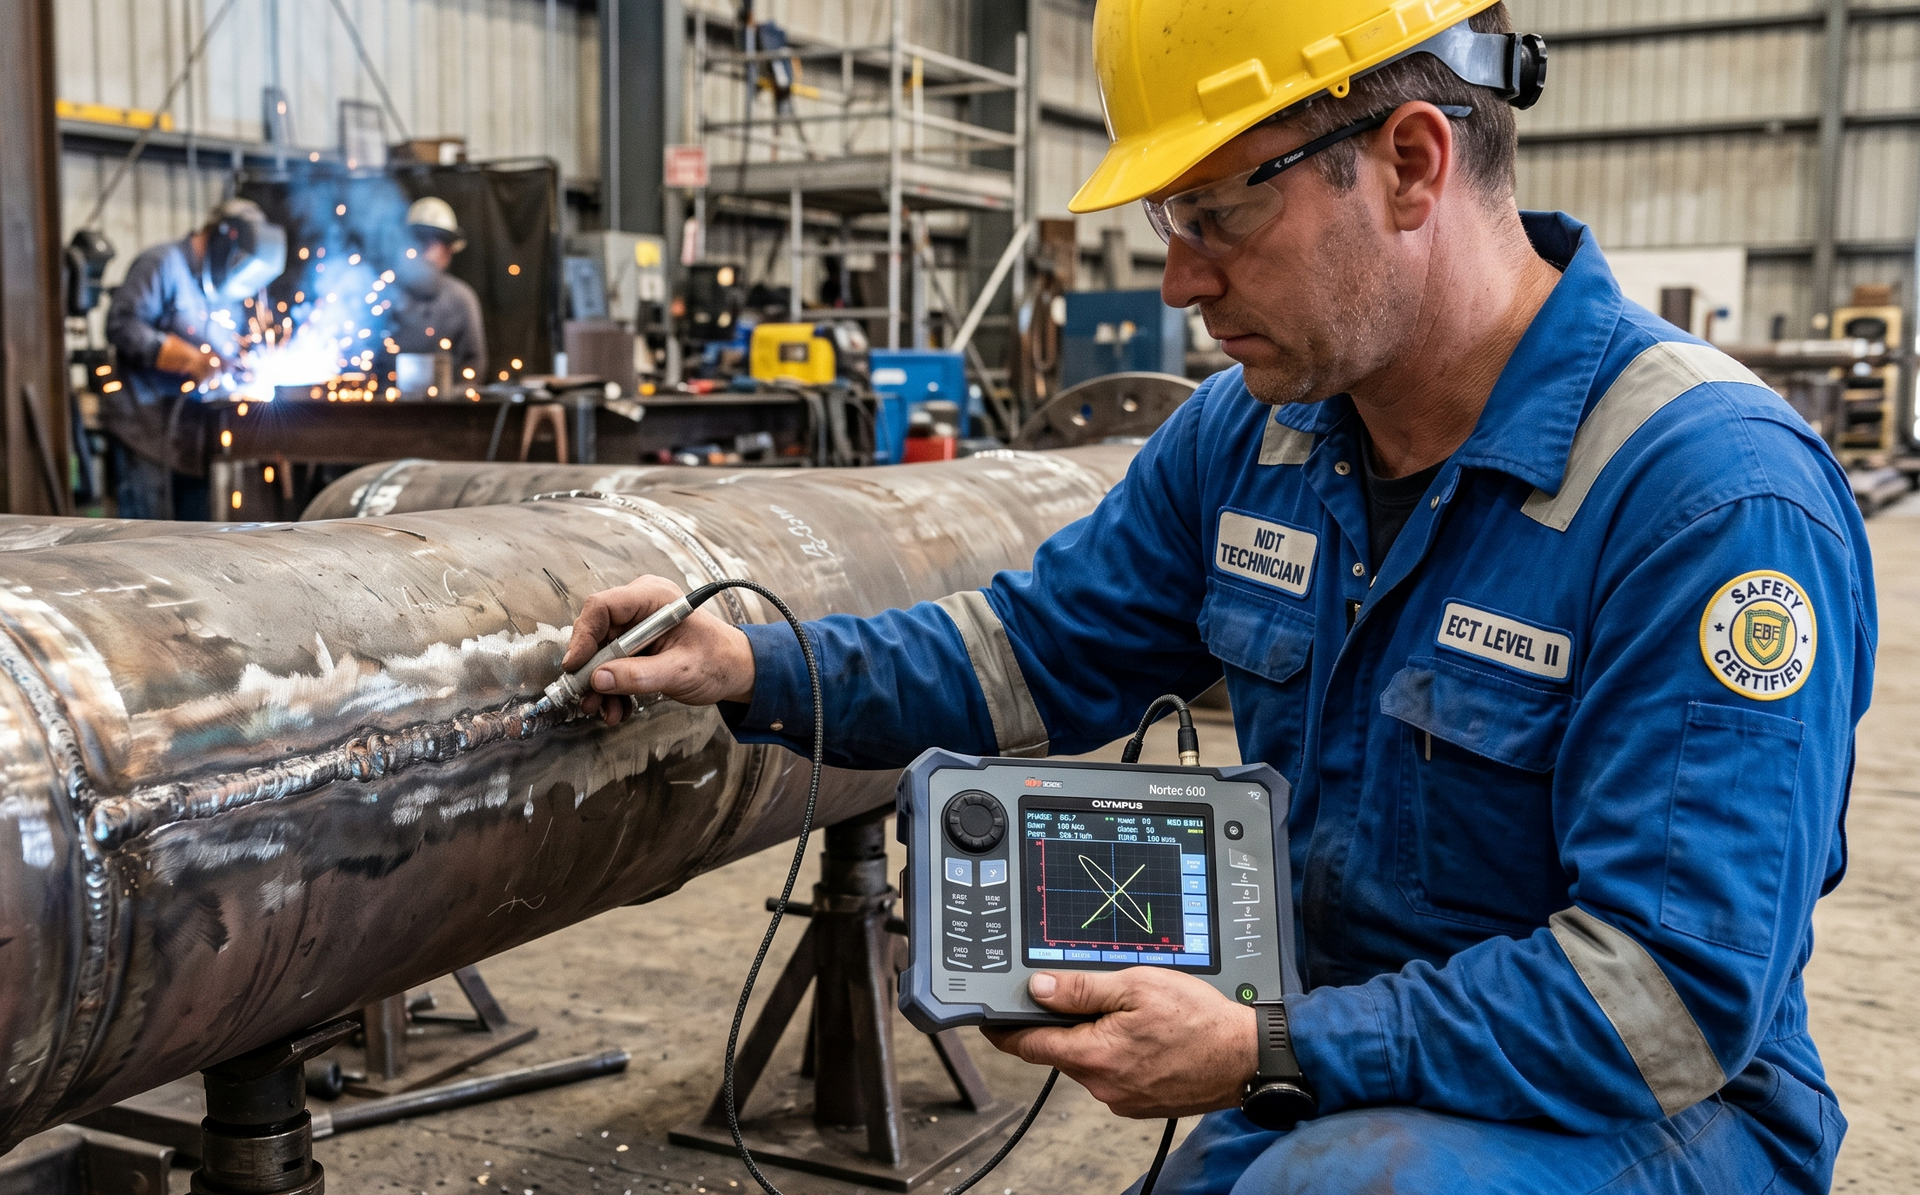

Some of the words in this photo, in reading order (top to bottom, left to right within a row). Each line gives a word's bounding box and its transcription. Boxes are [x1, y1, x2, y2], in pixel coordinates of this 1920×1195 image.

[1254, 527, 1285, 553] NDT
[1221, 543, 1305, 586] TECHNICIAN
[1731, 580, 1803, 609] SAFETY
[1446, 614, 1482, 642] ECT
[1482, 625, 1535, 662] LEVEL
[1544, 643, 1559, 666] II
[1714, 649, 1803, 691] CERTIFIED
[1092, 800, 1143, 809] OLYMPUS
[1149, 784, 1183, 796] Nortec
[1185, 786, 1206, 797] 600
